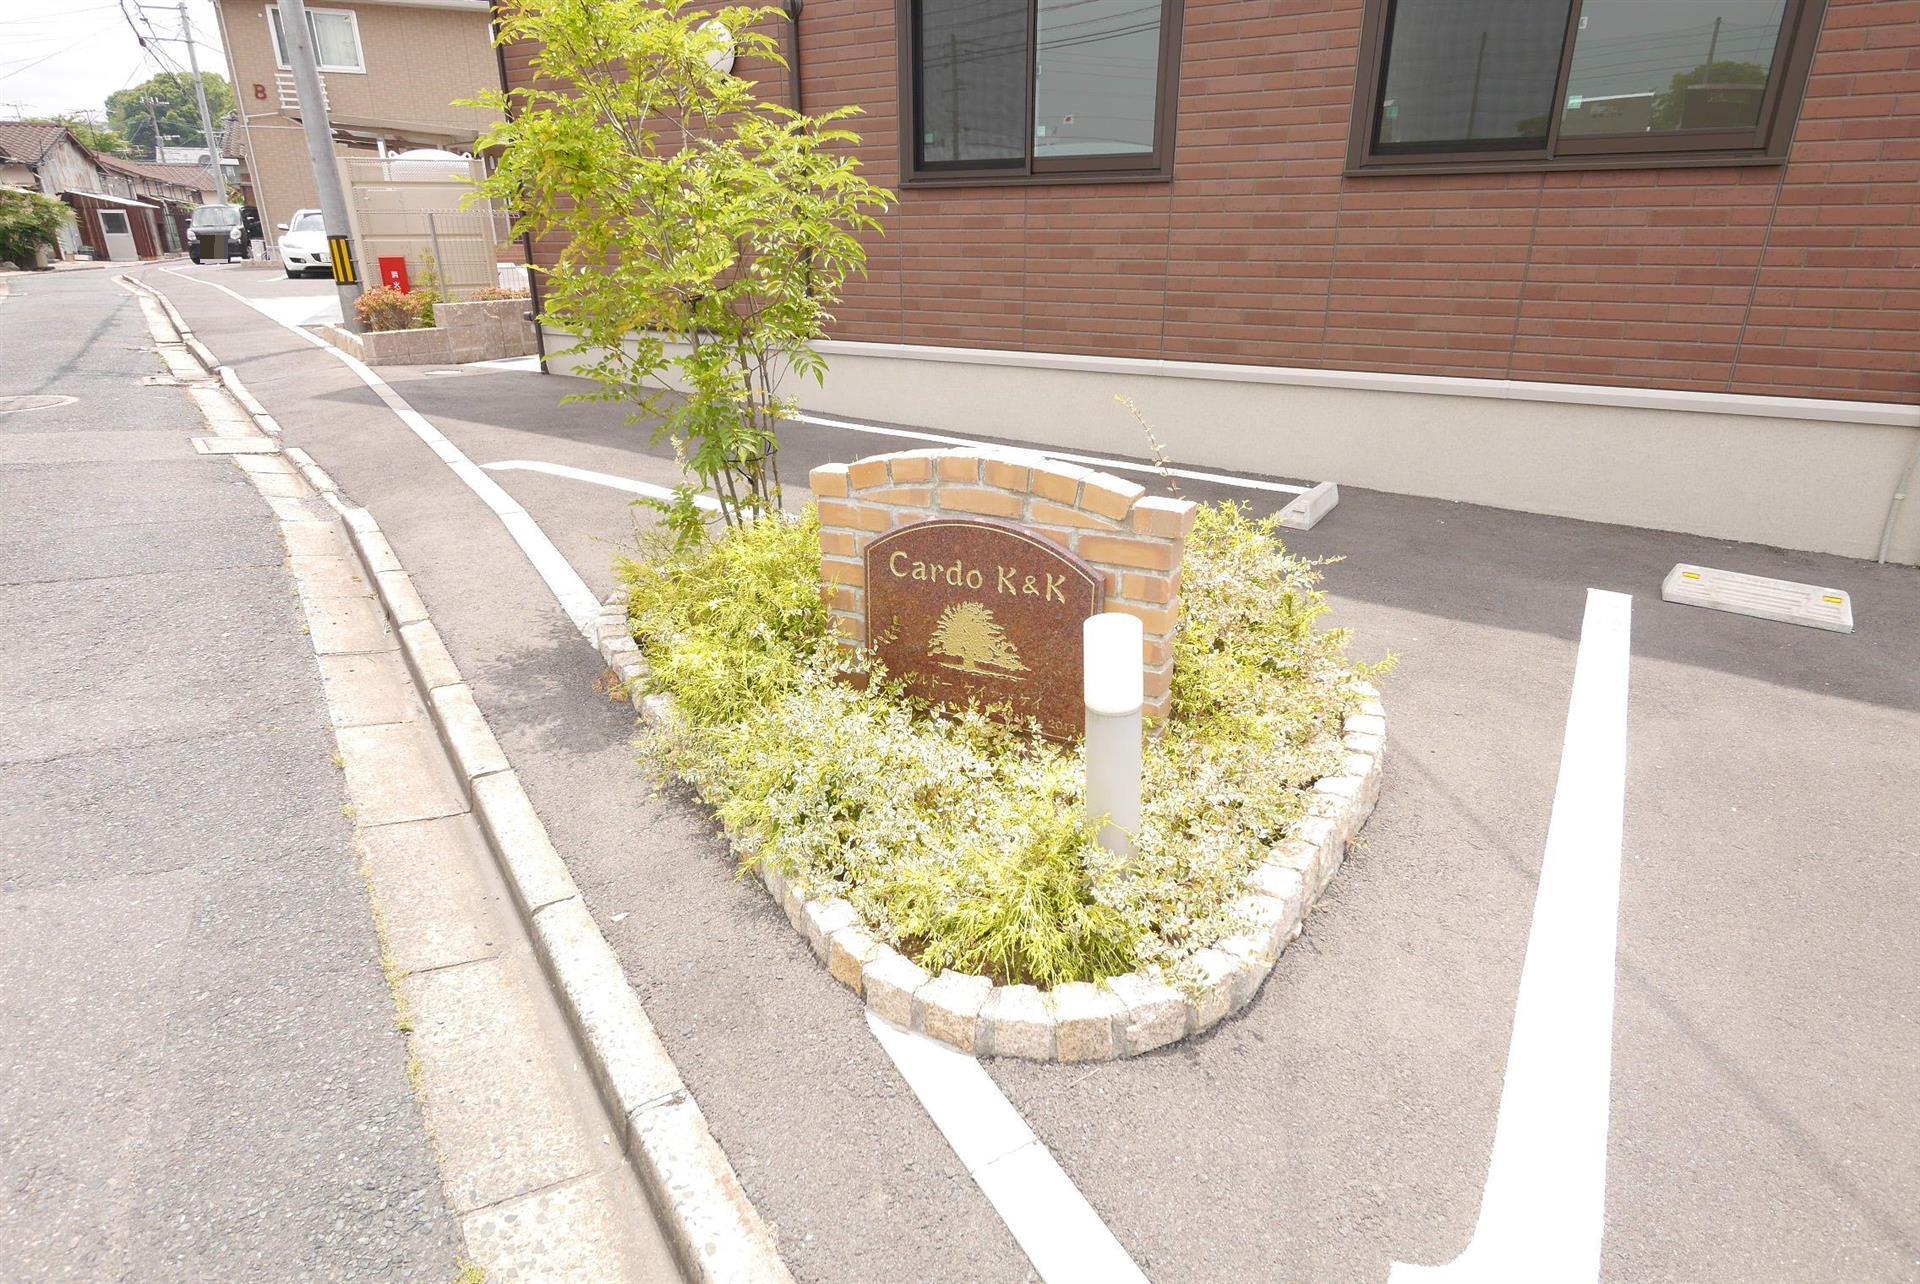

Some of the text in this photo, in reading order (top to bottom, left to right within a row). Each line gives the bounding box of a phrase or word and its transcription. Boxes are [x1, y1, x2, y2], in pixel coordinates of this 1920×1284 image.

[252, 83, 267, 100] B
[889, 551, 1066, 604] Cardo K&K
